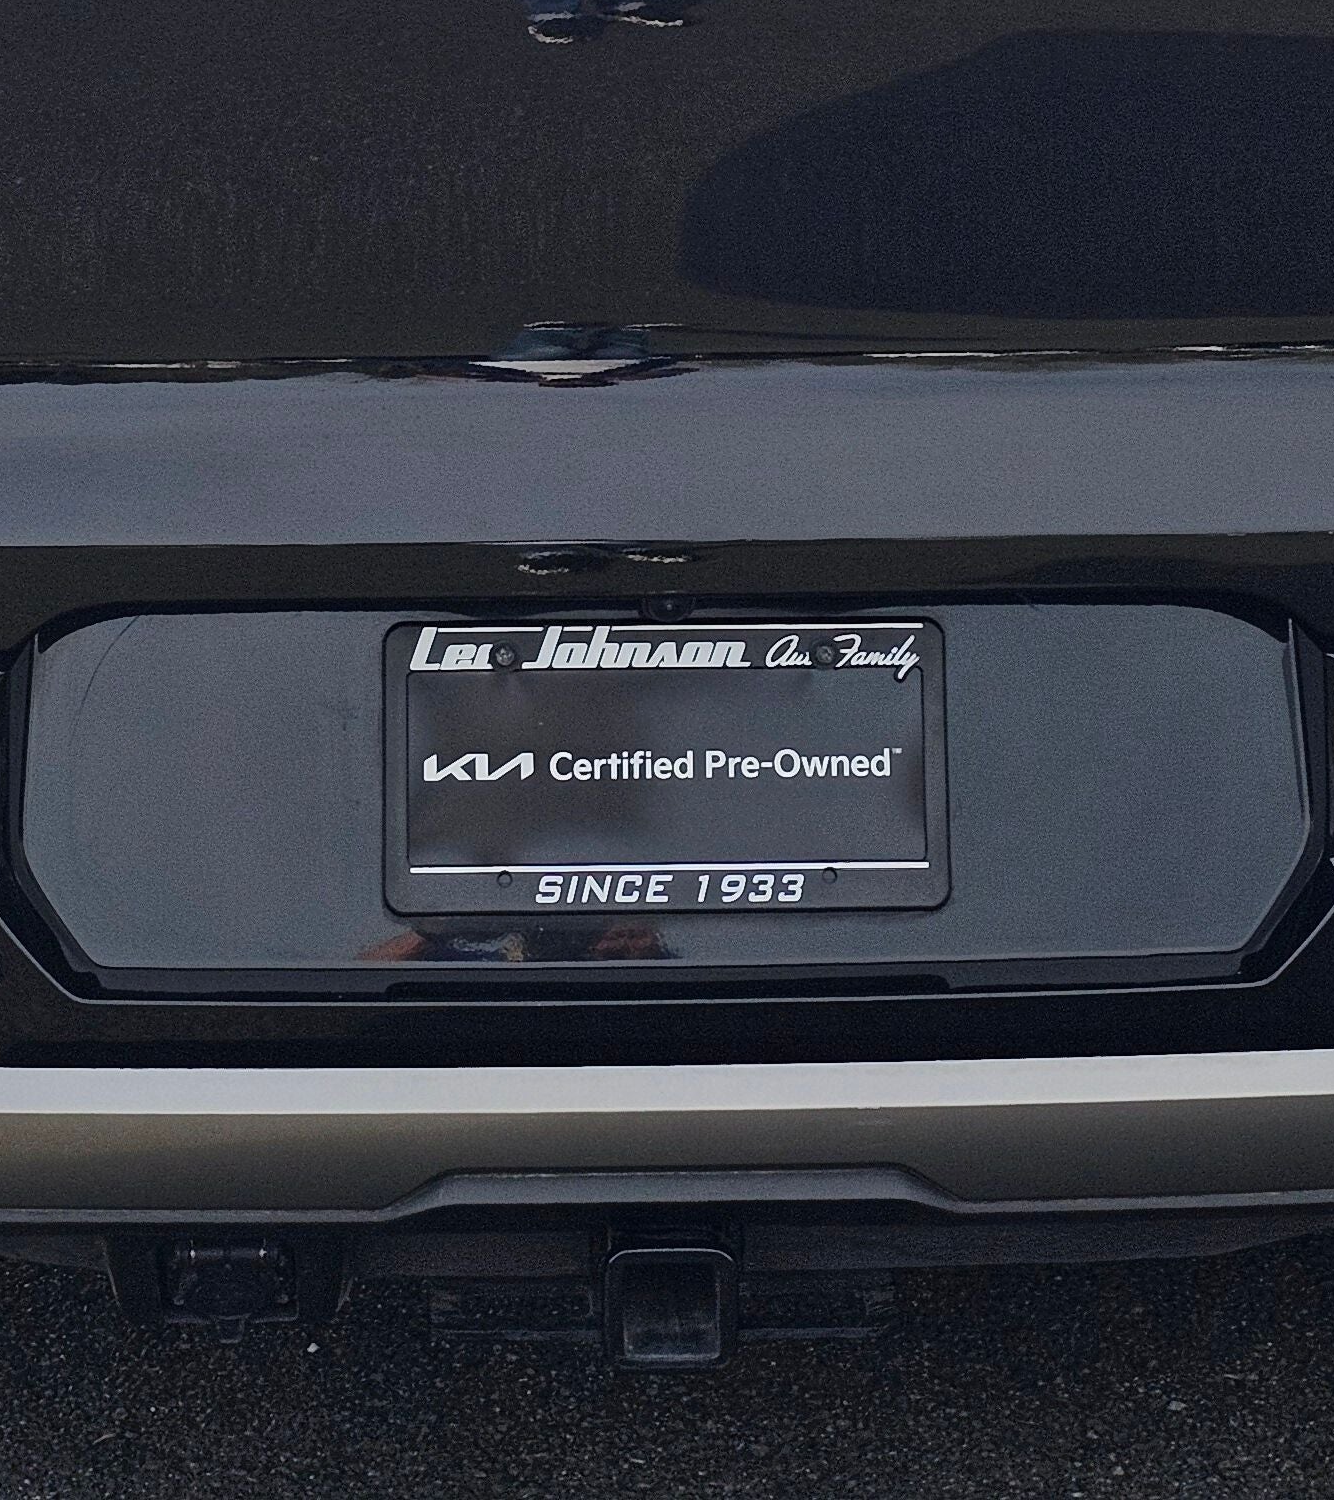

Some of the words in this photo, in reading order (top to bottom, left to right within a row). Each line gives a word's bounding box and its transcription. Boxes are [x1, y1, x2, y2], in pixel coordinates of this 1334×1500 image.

[521, 625, 752, 669] Johnson
[833, 633, 920, 680] Family
[423, 752, 535, 782] KIA
[549, 750, 695, 781] Certified
[535, 874, 674, 904] SINCE
[697, 873, 805, 903] 1933
